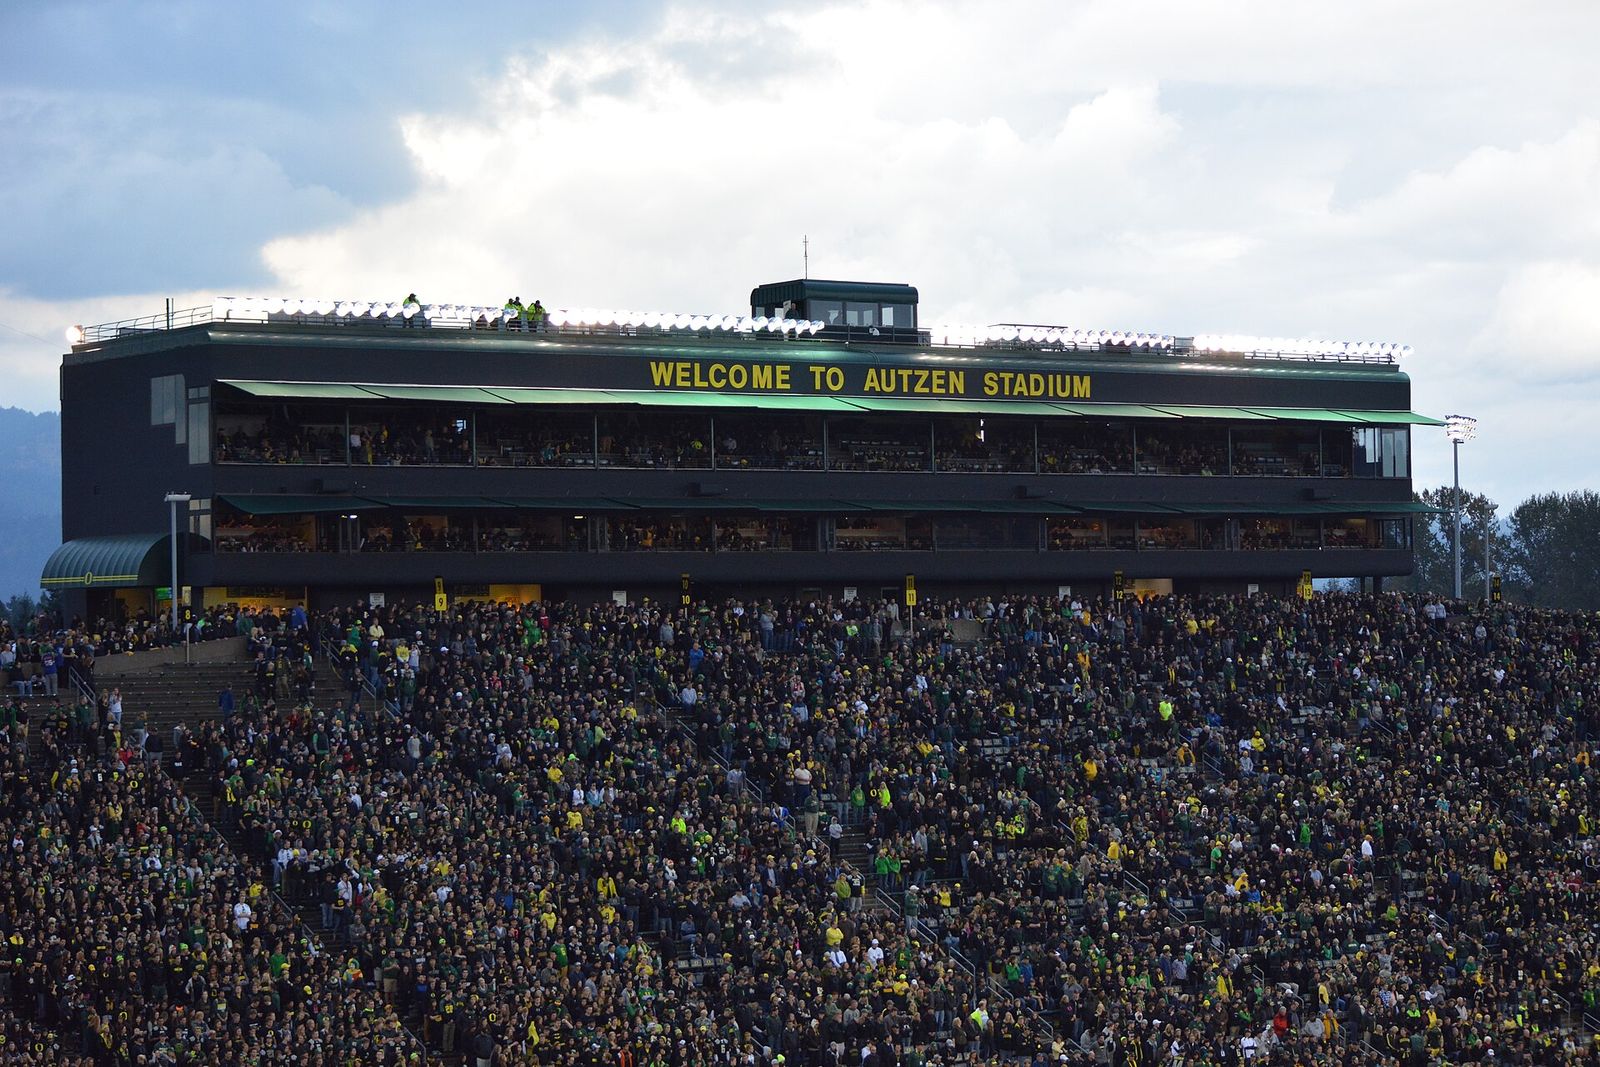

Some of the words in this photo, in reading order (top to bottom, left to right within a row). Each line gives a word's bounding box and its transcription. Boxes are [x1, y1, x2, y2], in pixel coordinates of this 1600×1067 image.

[651, 362, 789, 389] WELCOME
[811, 366, 844, 391] TO
[864, 368, 964, 393] AUTZEN
[984, 373, 1090, 398] STADIUM
[85, 572, 93, 585] O
[1115, 590, 1124, 599] 12
[1304, 587, 1312, 596] 13
[682, 594, 690, 605] 10
[908, 592, 915, 602] 11
[1493, 592, 1500, 601] 14
[438, 599, 444, 607] 9
[184, 609, 191, 620] 8
[130, 780, 139, 789] O
[870, 788, 877, 798] O
[302, 820, 312, 829] O
[488, 1013, 496, 1022] O
[35, 1043, 43, 1052] O
